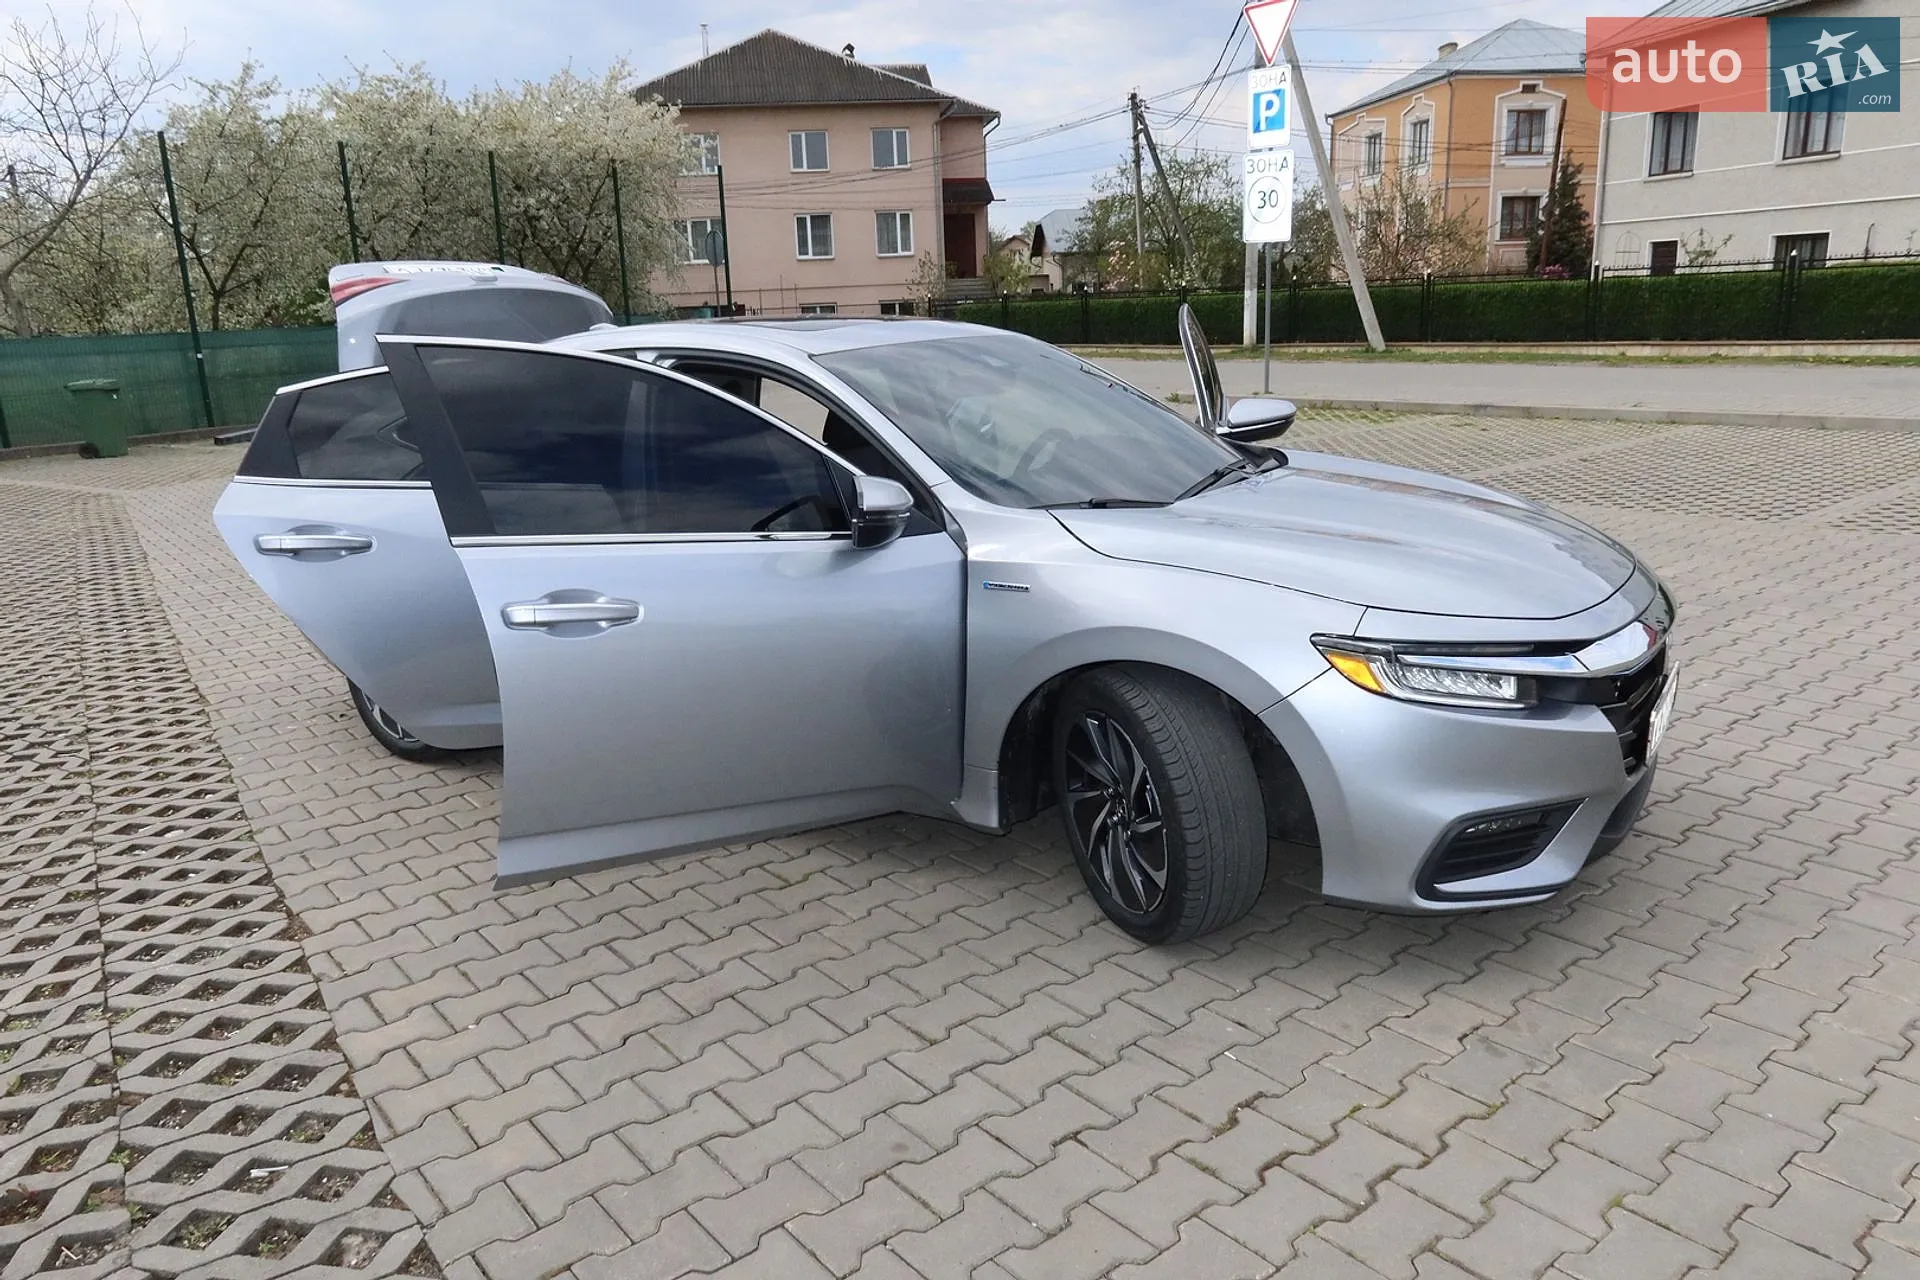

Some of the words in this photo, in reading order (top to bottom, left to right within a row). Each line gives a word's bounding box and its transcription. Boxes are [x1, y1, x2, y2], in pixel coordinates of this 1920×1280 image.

[1250, 71, 1287, 89] ЗОНА
[1259, 93, 1280, 131] P
[1246, 156, 1289, 174] ЗОНА
[1257, 189, 1279, 209] 30
